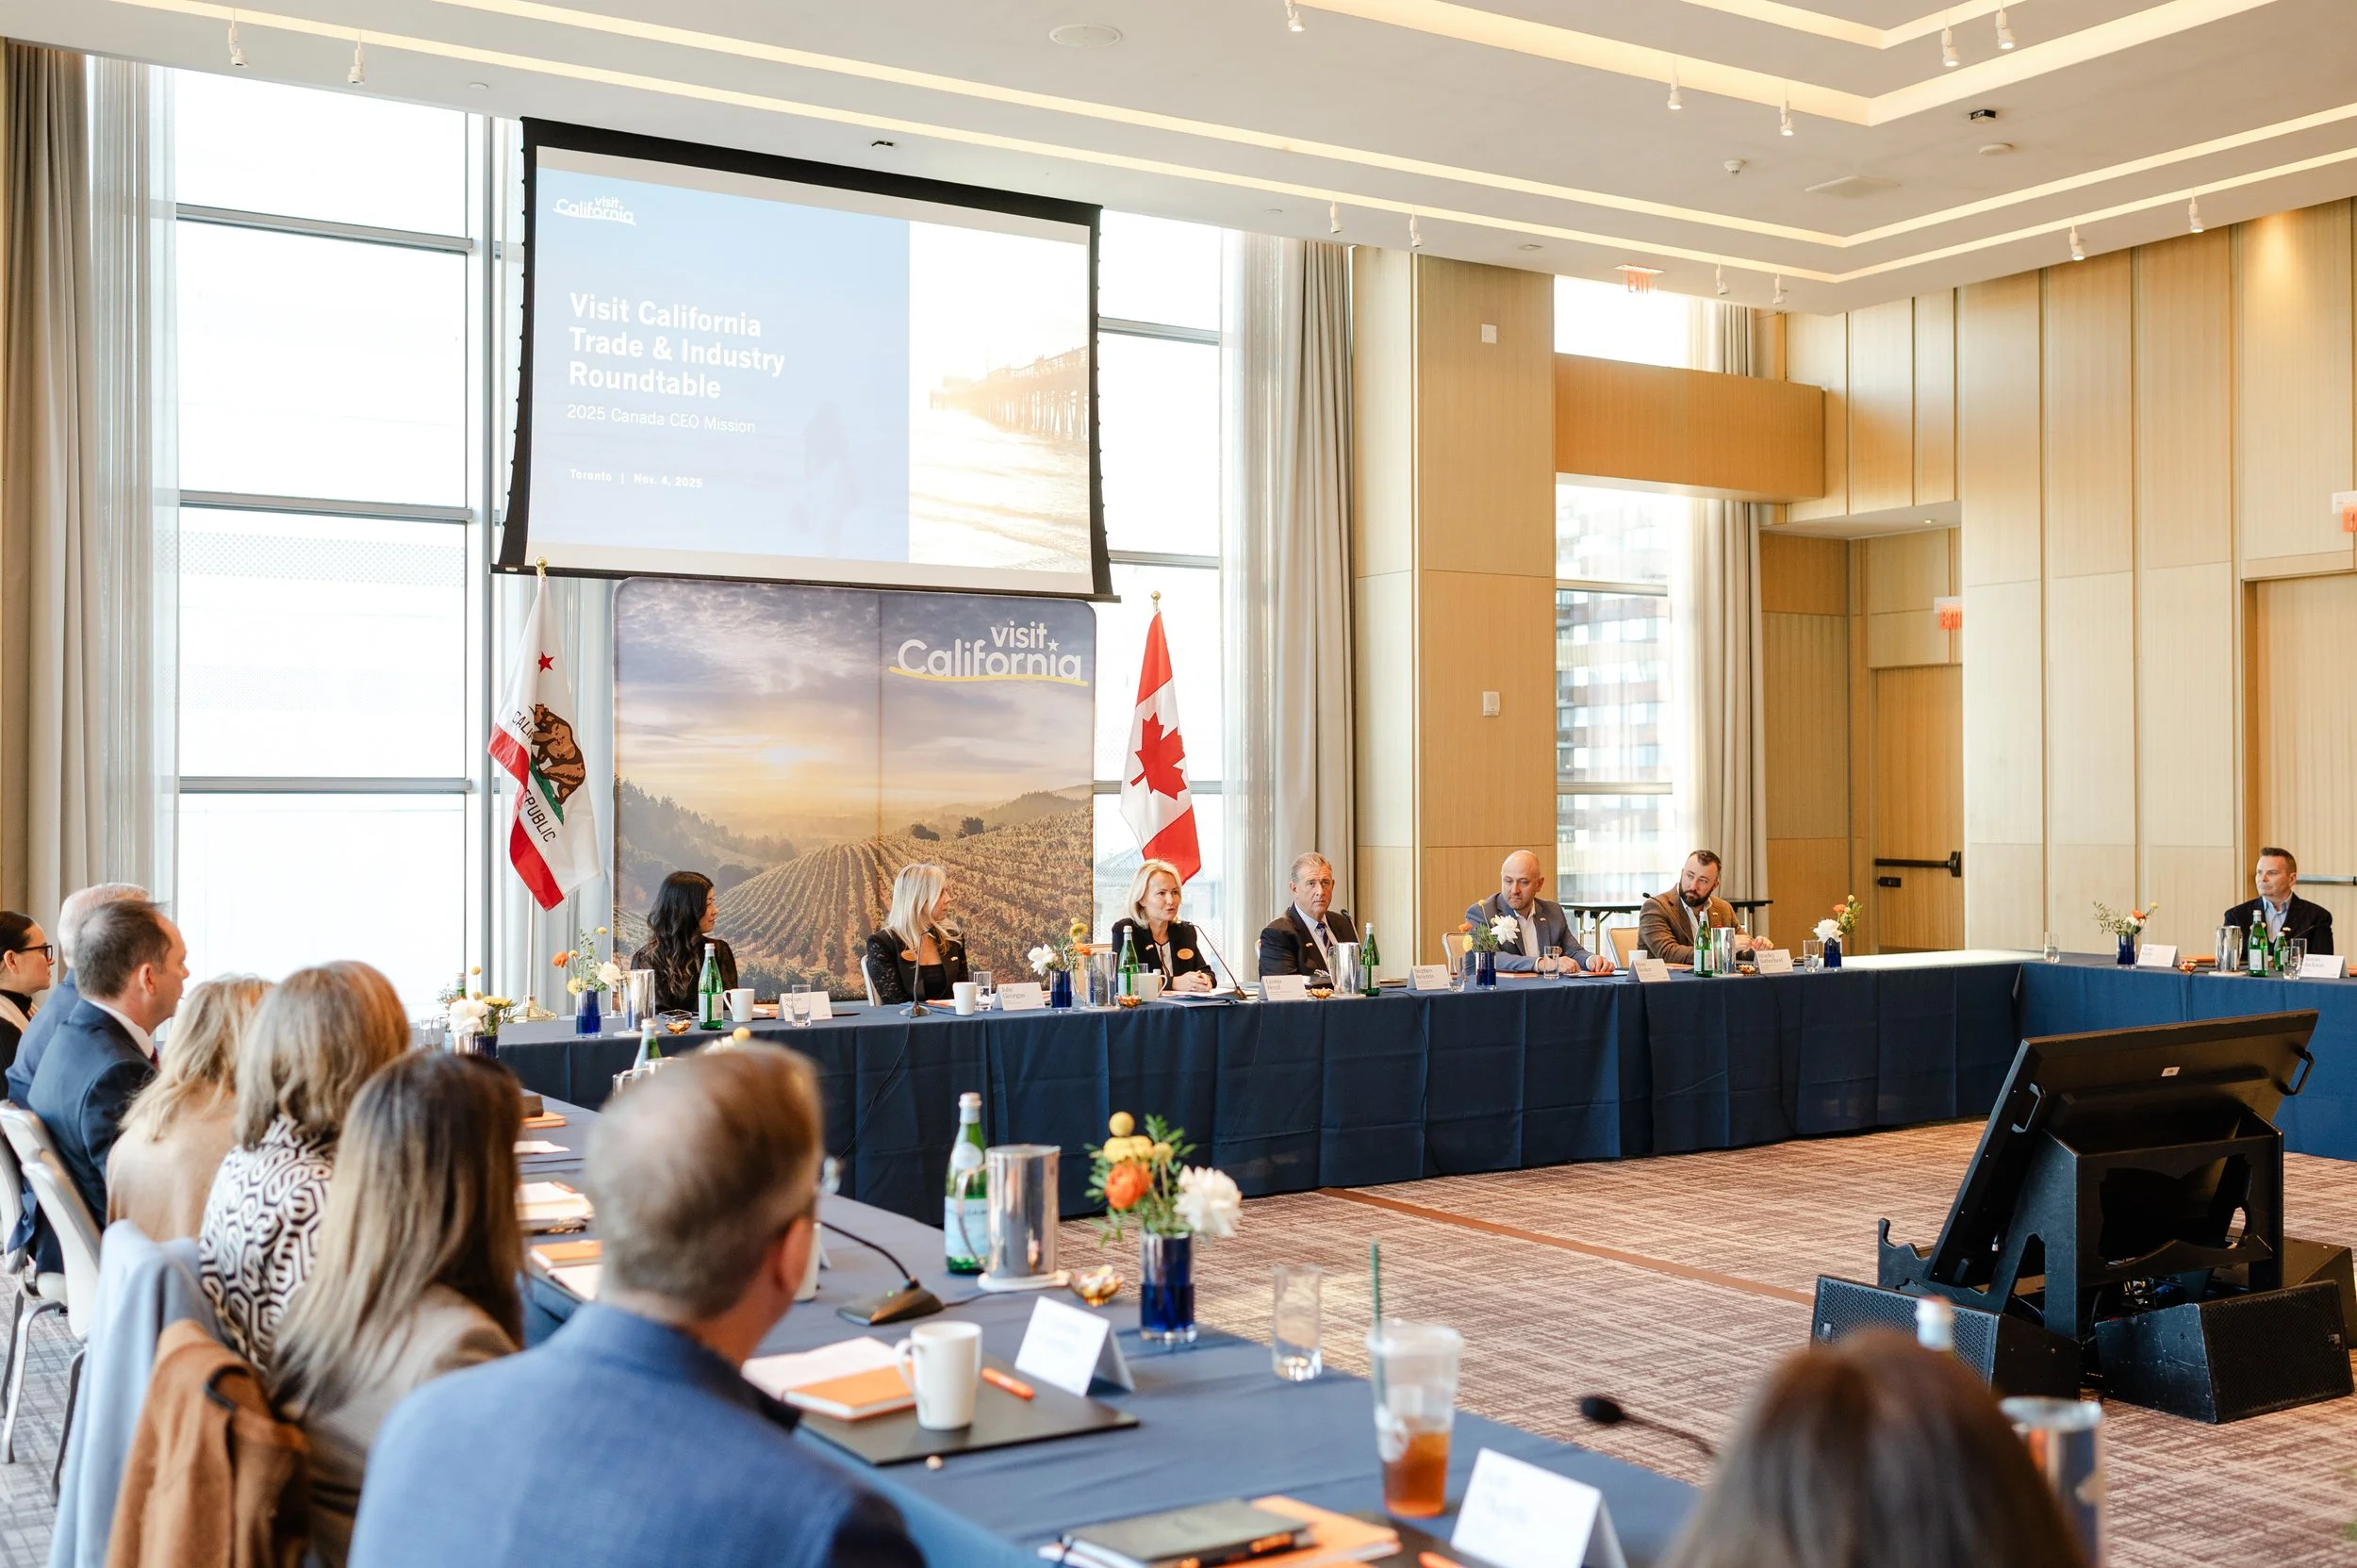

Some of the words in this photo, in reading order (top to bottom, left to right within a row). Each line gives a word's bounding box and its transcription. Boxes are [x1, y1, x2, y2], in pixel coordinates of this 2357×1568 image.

[555, 198, 635, 223] California
[595, 196, 620, 209] visit
[569, 292, 630, 323] Visit
[638, 300, 762, 338] California
[569, 326, 644, 358] Trade
[651, 336, 673, 362] &
[681, 338, 785, 378] Industry
[569, 360, 721, 399] Roundtable
[567, 404, 605, 421] 2025
[611, 407, 665, 426] Canada
[669, 413, 700, 429] CEO
[704, 416, 755, 434] Mission
[569, 469, 613, 482] Toronto
[634, 473, 658, 485] Nov.
[661, 475, 671, 487] 4,
[674, 476, 703, 488] 2025
[990, 620, 1047, 649] visit
[898, 638, 1081, 681] California
